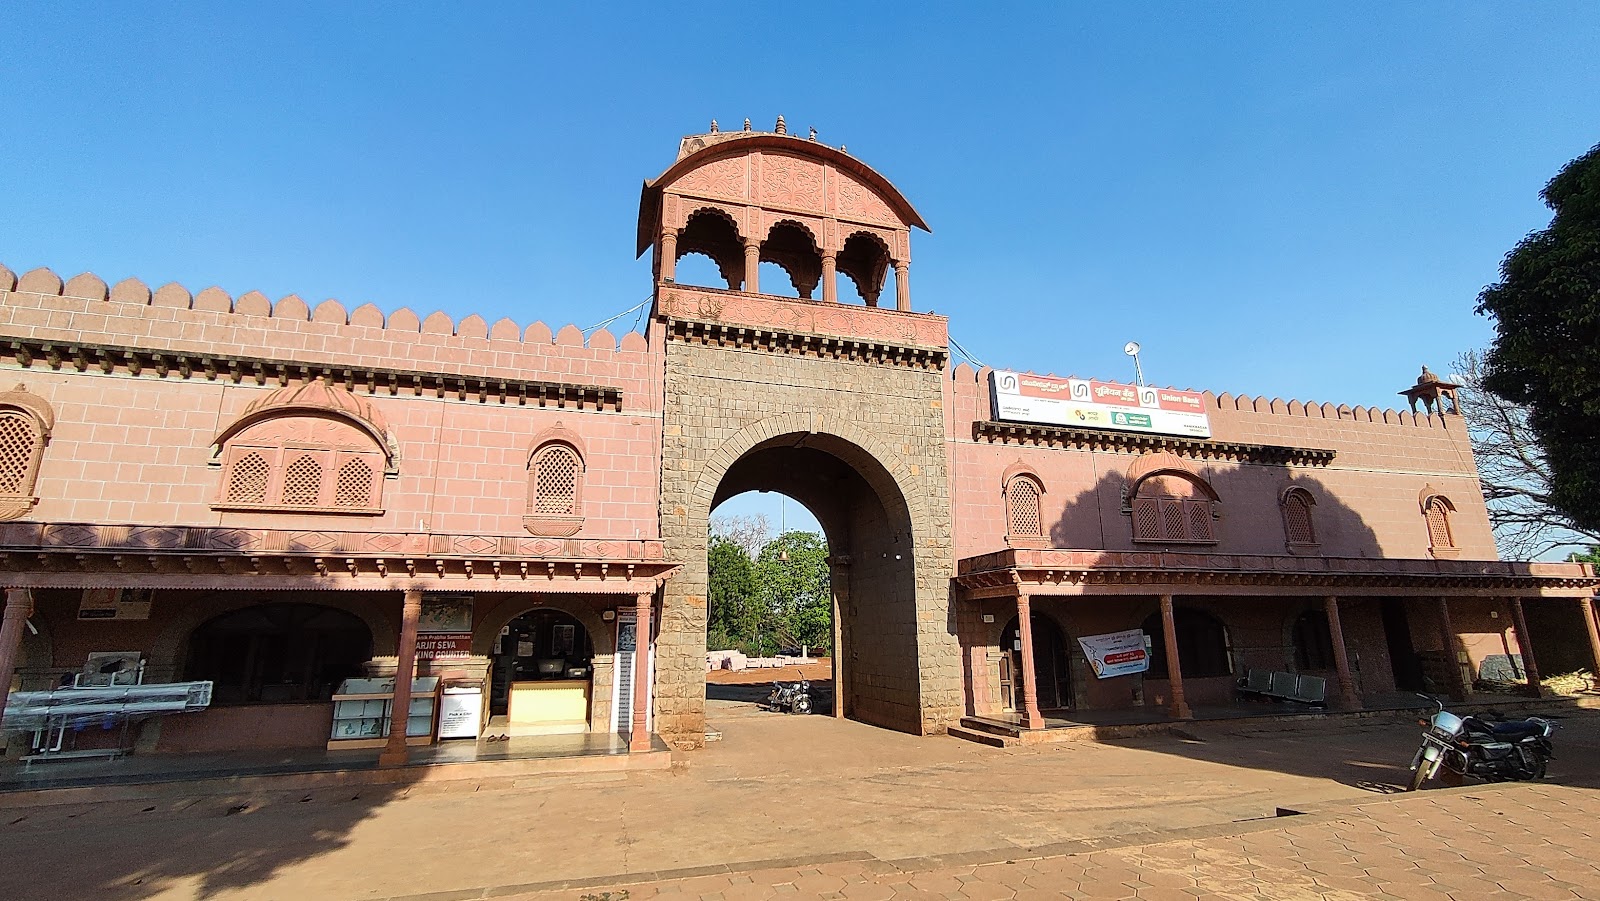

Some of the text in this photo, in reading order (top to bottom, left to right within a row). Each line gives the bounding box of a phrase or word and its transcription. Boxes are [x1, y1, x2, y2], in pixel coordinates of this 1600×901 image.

[1161, 393, 1200, 405] Union Bank
[416, 640, 456, 650] ARJIT SEVA
[416, 650, 470, 659] KING COUNTER
